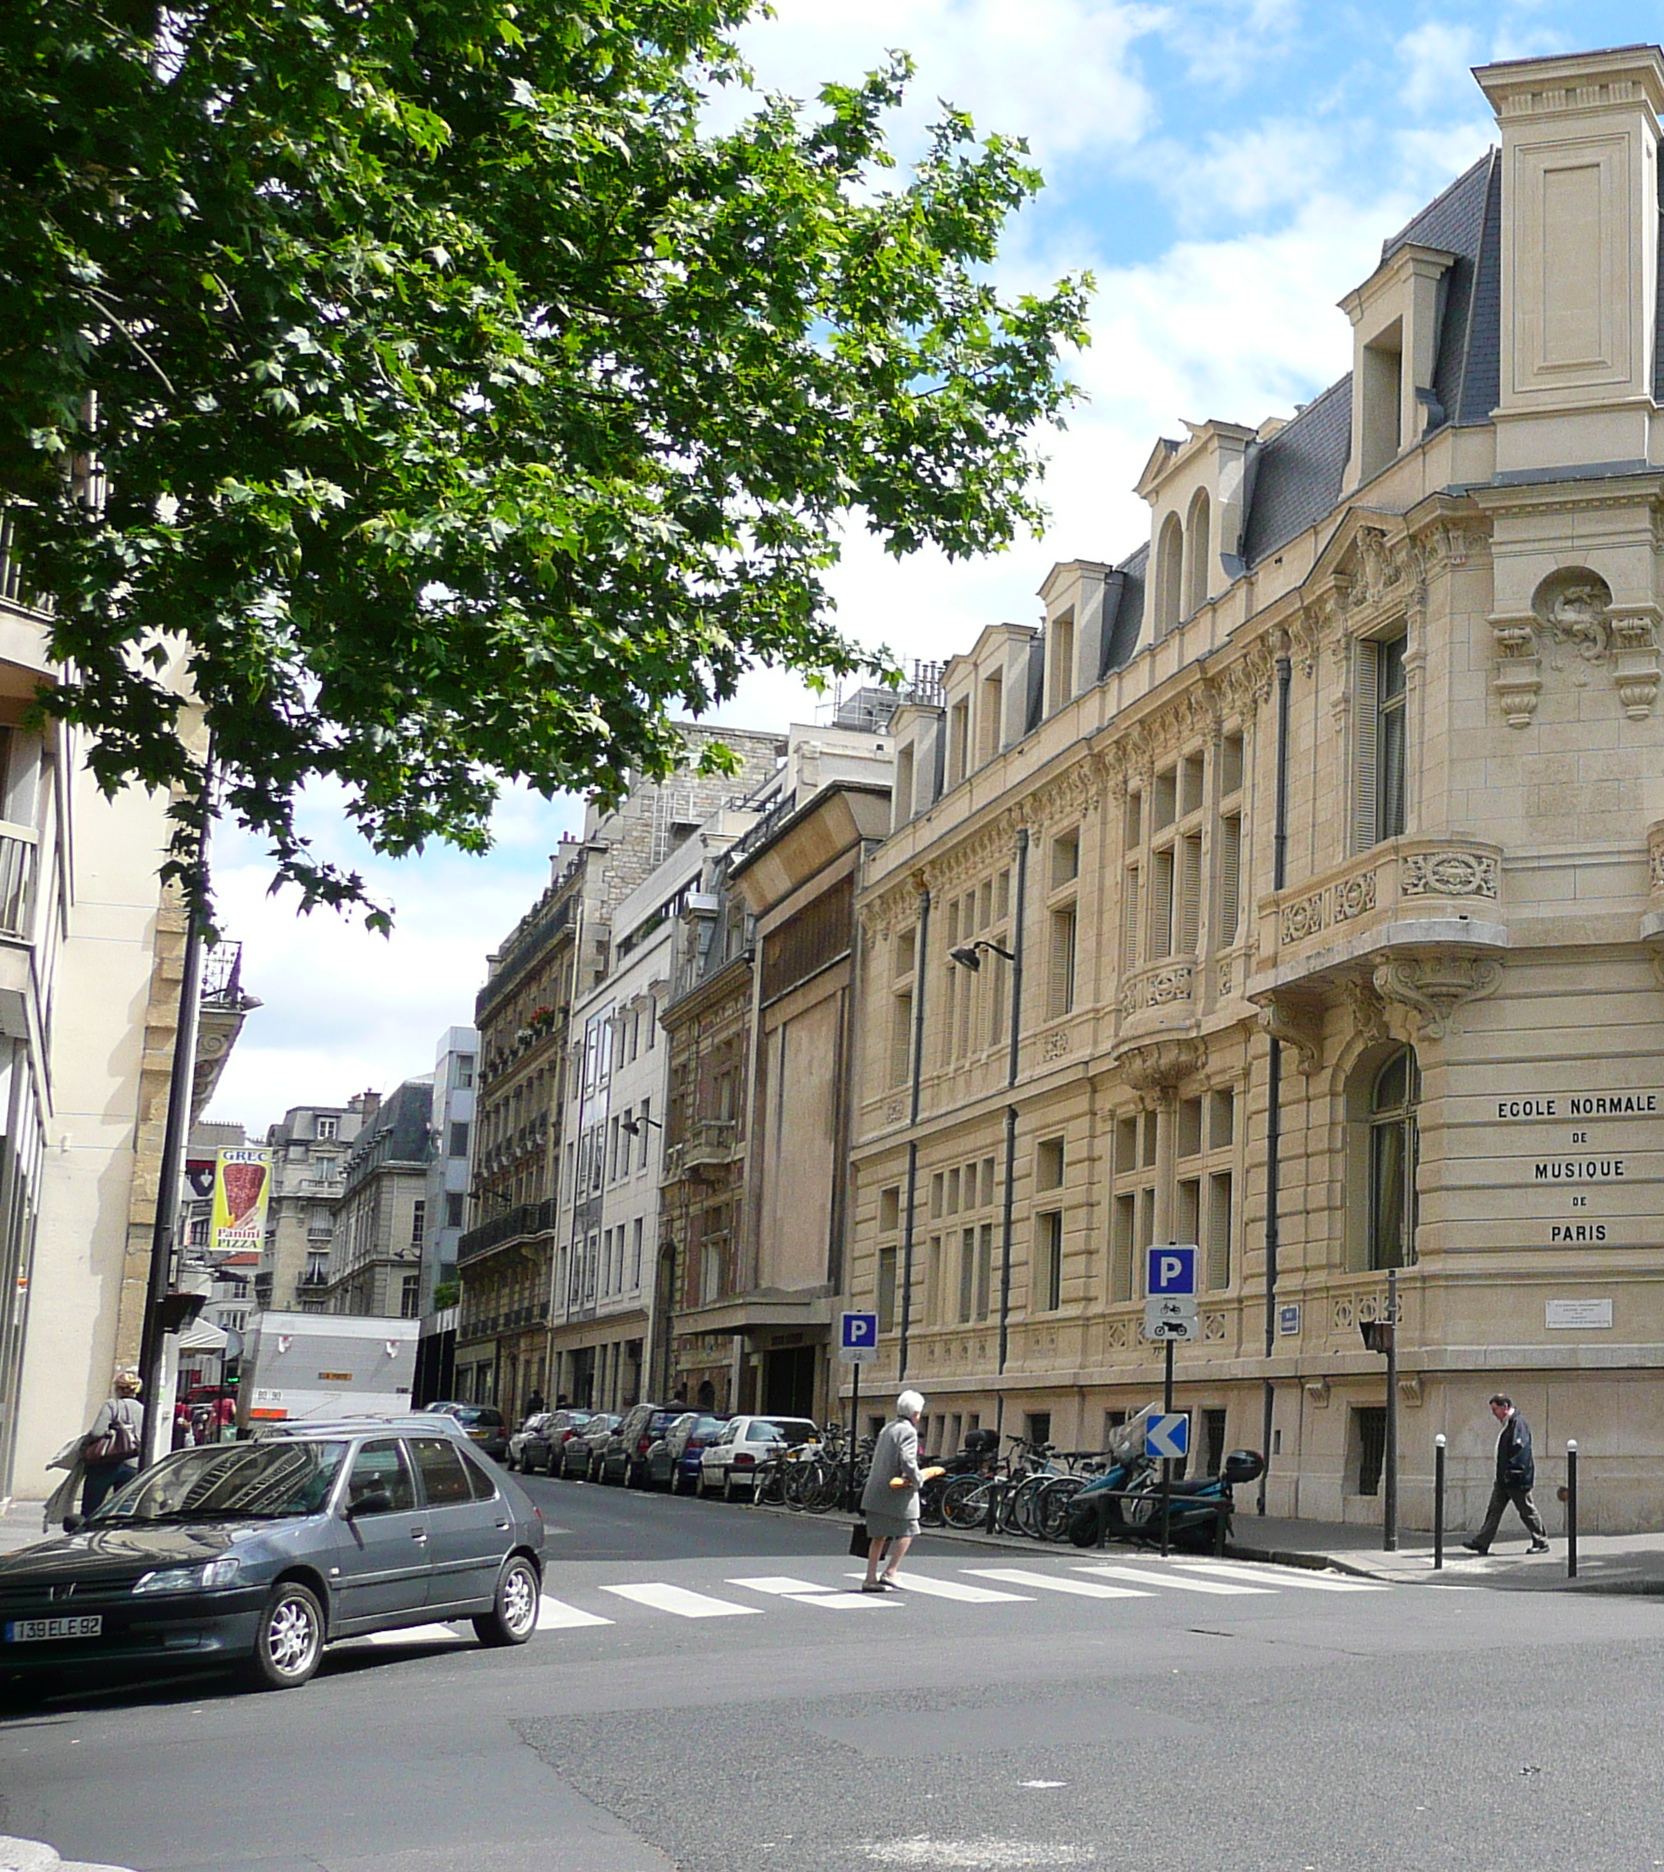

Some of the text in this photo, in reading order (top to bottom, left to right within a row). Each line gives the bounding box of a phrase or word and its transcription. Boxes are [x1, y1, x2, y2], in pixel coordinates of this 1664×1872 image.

[1498, 1096, 1657, 1118] ECOLE NORMALE
[1572, 1132, 1587, 1143] DE
[222, 1151, 268, 1162] GREC
[1535, 1161, 1624, 1179] MUSIQUE
[1572, 1197, 1587, 1206] DE
[218, 1228, 260, 1238] Panini
[1551, 1225, 1606, 1241] PARIS
[217, 1239, 257, 1248] PIZZA
[1160, 1256, 1182, 1287] P
[851, 1320, 867, 1342] P
[20, 1617, 99, 1639] 139 ELE 92
